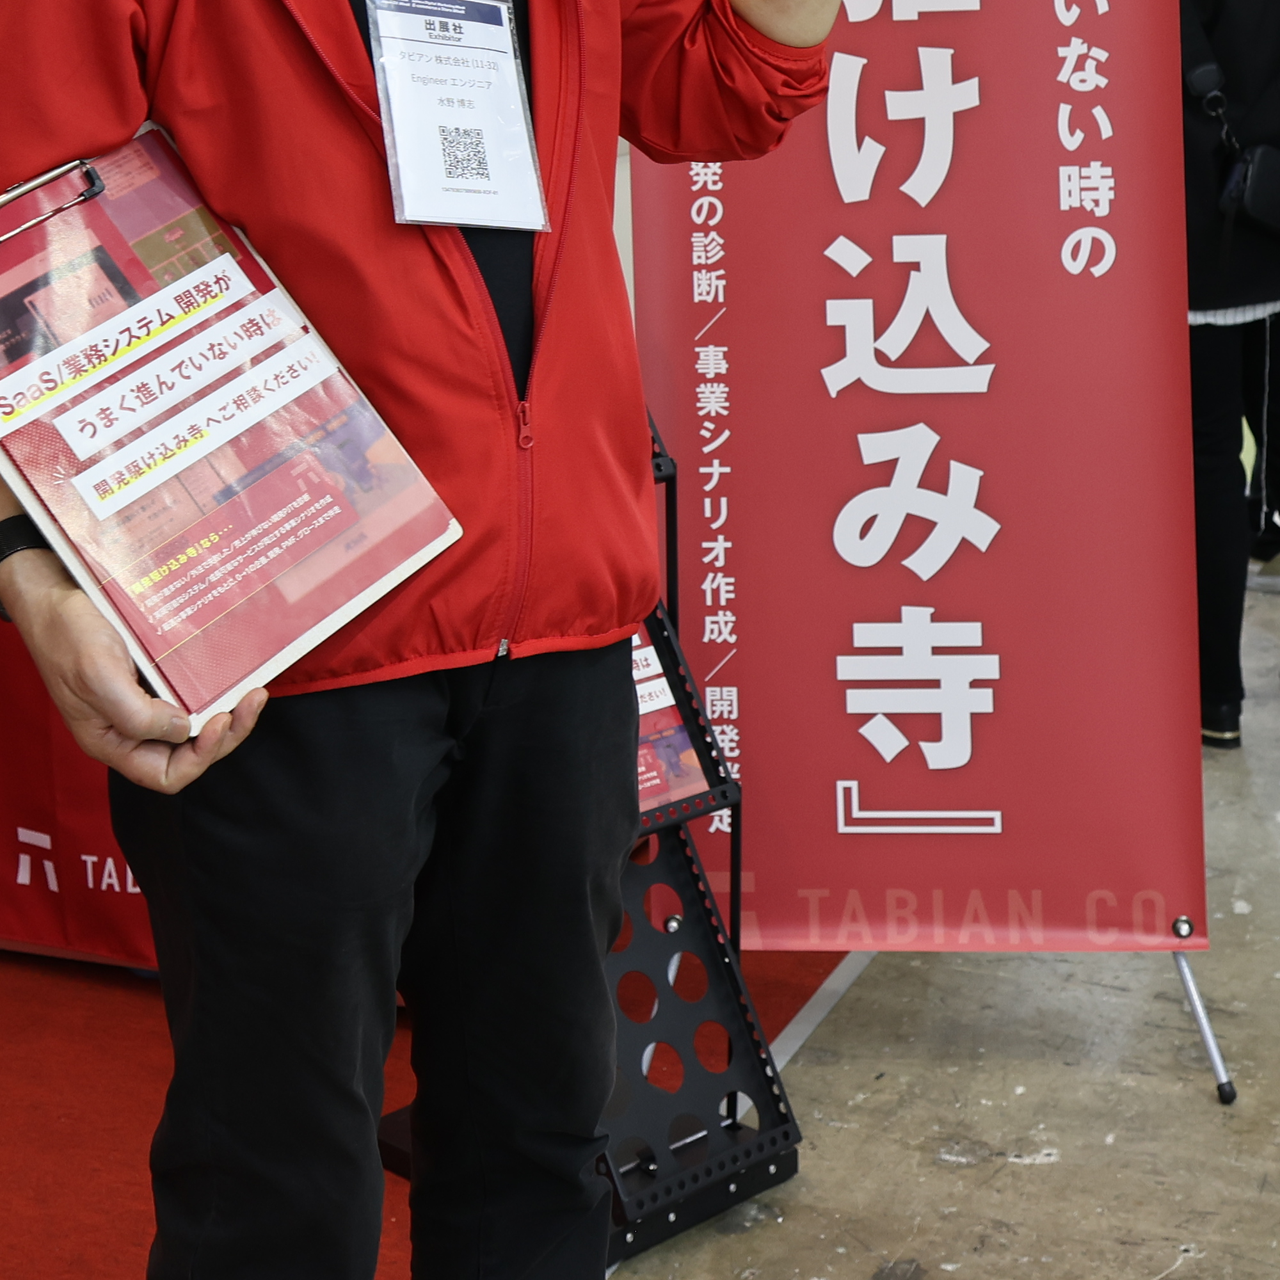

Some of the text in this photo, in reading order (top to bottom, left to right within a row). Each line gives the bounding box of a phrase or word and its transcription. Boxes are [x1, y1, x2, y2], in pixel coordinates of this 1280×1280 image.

[424, 18, 464, 35] 出展社
[428, 32, 464, 44] Exhibitor
[399, 50, 434, 64] タビアン
[434, 54, 471, 69] 株式会社
[411, 73, 494, 91] Engineer エンジニア
[173, 269, 233, 316] 開発が
[77, 307, 283, 440] うまく進んでいない時は
[796, 887, 1045, 947] TABIAN
